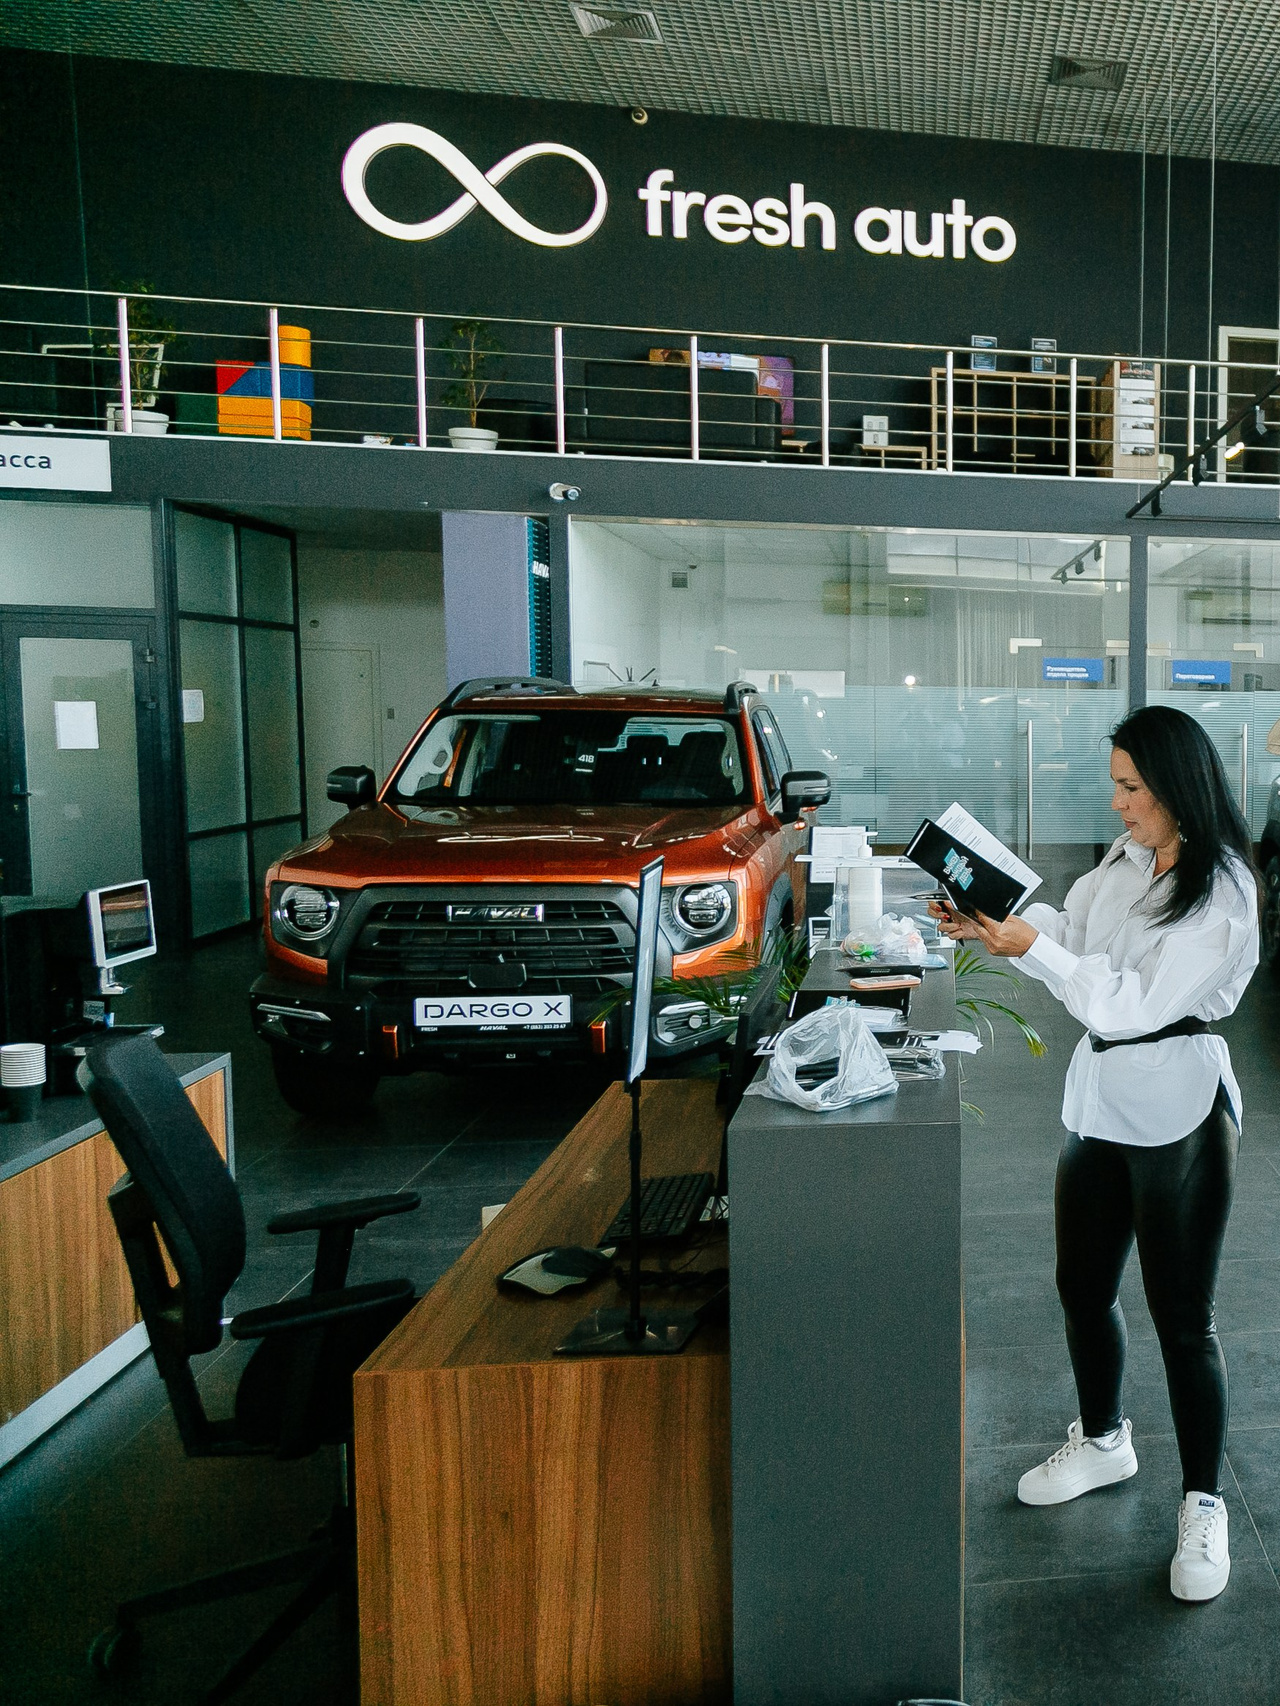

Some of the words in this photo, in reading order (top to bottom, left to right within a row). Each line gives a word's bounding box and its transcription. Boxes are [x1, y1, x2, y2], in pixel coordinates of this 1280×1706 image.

[638, 168, 836, 251] fresh
[854, 199, 1018, 263] auto
[578, 754, 595, 763] 418
[424, 1002, 533, 1019] DARGO
[543, 1002, 564, 1017] X
